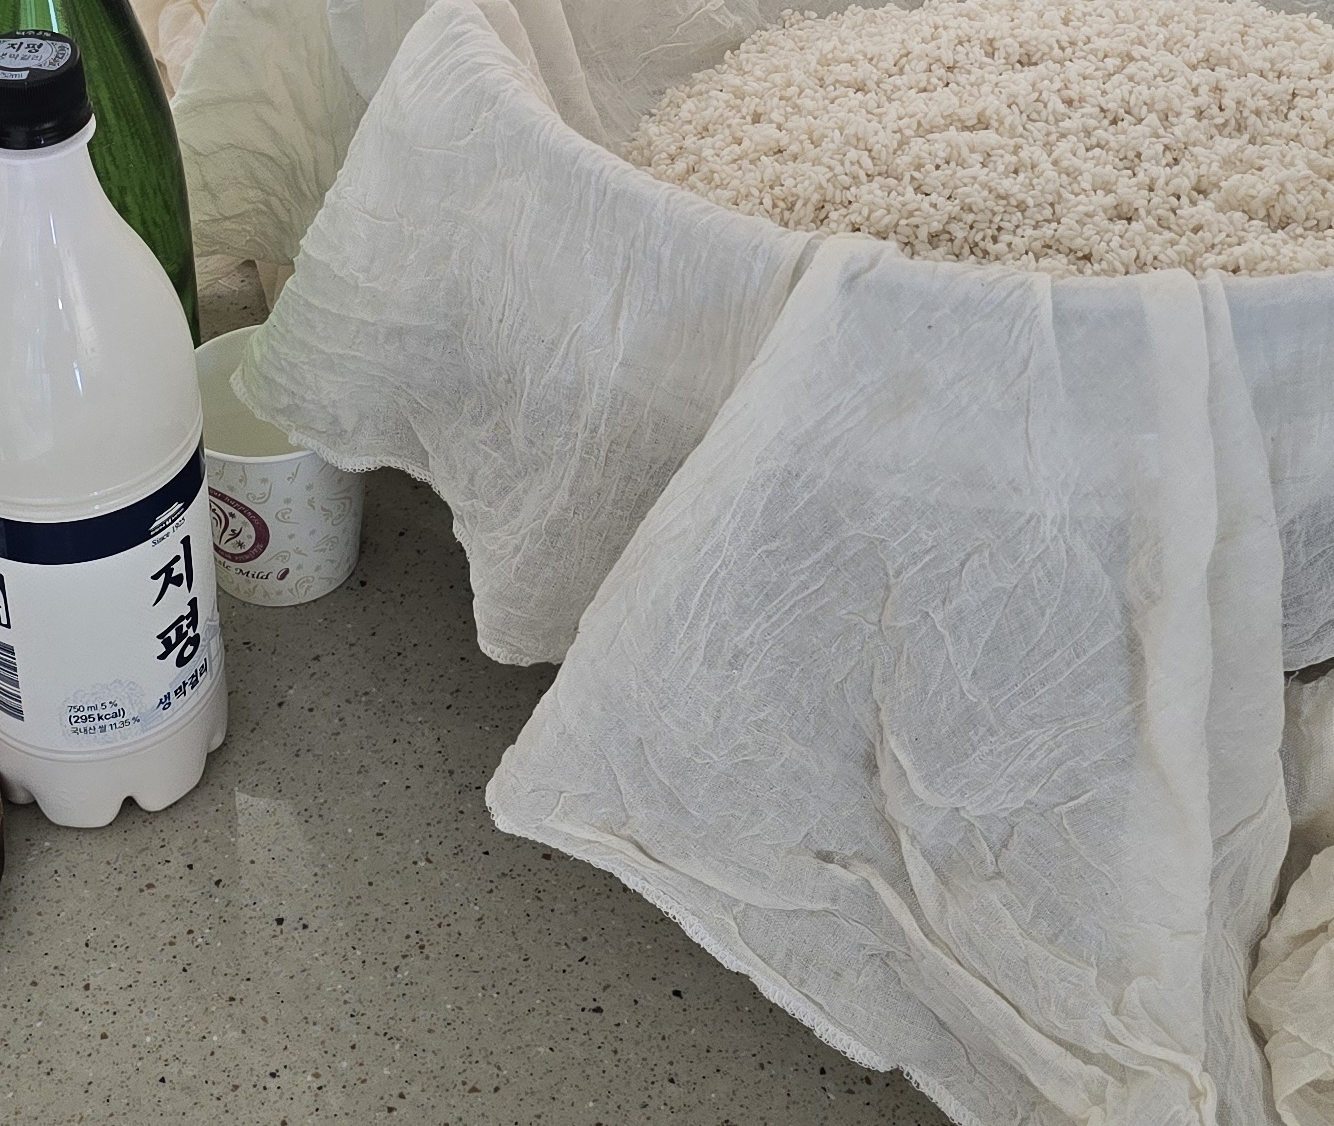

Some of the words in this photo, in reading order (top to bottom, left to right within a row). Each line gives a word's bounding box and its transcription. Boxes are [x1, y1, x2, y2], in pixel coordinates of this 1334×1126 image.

[5, 41, 44, 54] 지평
[151, 531, 171, 548] Since
[234, 567, 273, 580] Mild
[150, 534, 201, 669] 지평
[67, 704, 85, 713] 750
[86, 703, 98, 712] ml
[100, 701, 107, 710] 5
[68, 714, 96, 726] (295
[97, 707, 126, 722] kcal)
[70, 725, 97, 736] 국내산
